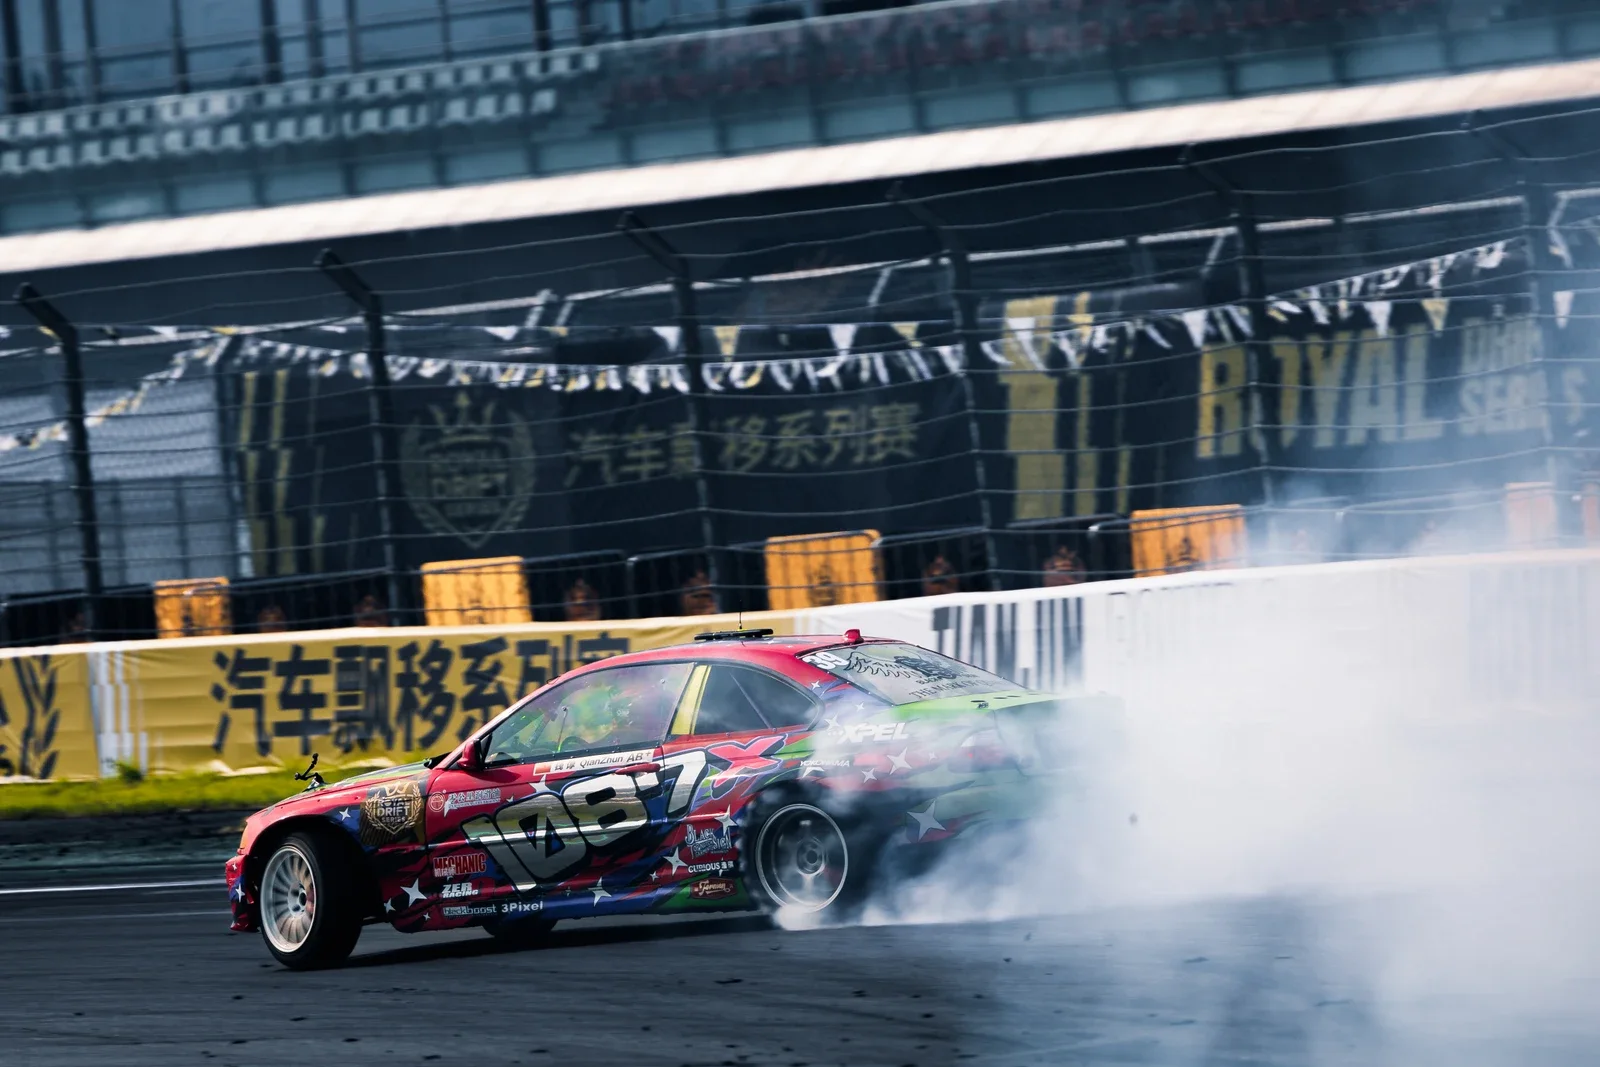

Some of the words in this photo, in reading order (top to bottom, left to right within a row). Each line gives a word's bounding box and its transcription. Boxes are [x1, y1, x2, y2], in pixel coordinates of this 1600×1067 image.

[801, 651, 849, 670] 39
[210, 632, 630, 757] 汽车飘移系列
[837, 722, 910, 744] XPEL
[580, 756, 624, 769] QianZhun
[800, 759, 850, 768] YOKOHAMA
[376, 805, 411, 817] DRIFT
[434, 853, 486, 875] MECHANIC
[442, 888, 479, 899] RACING
[501, 900, 544, 913] 3Pixel
